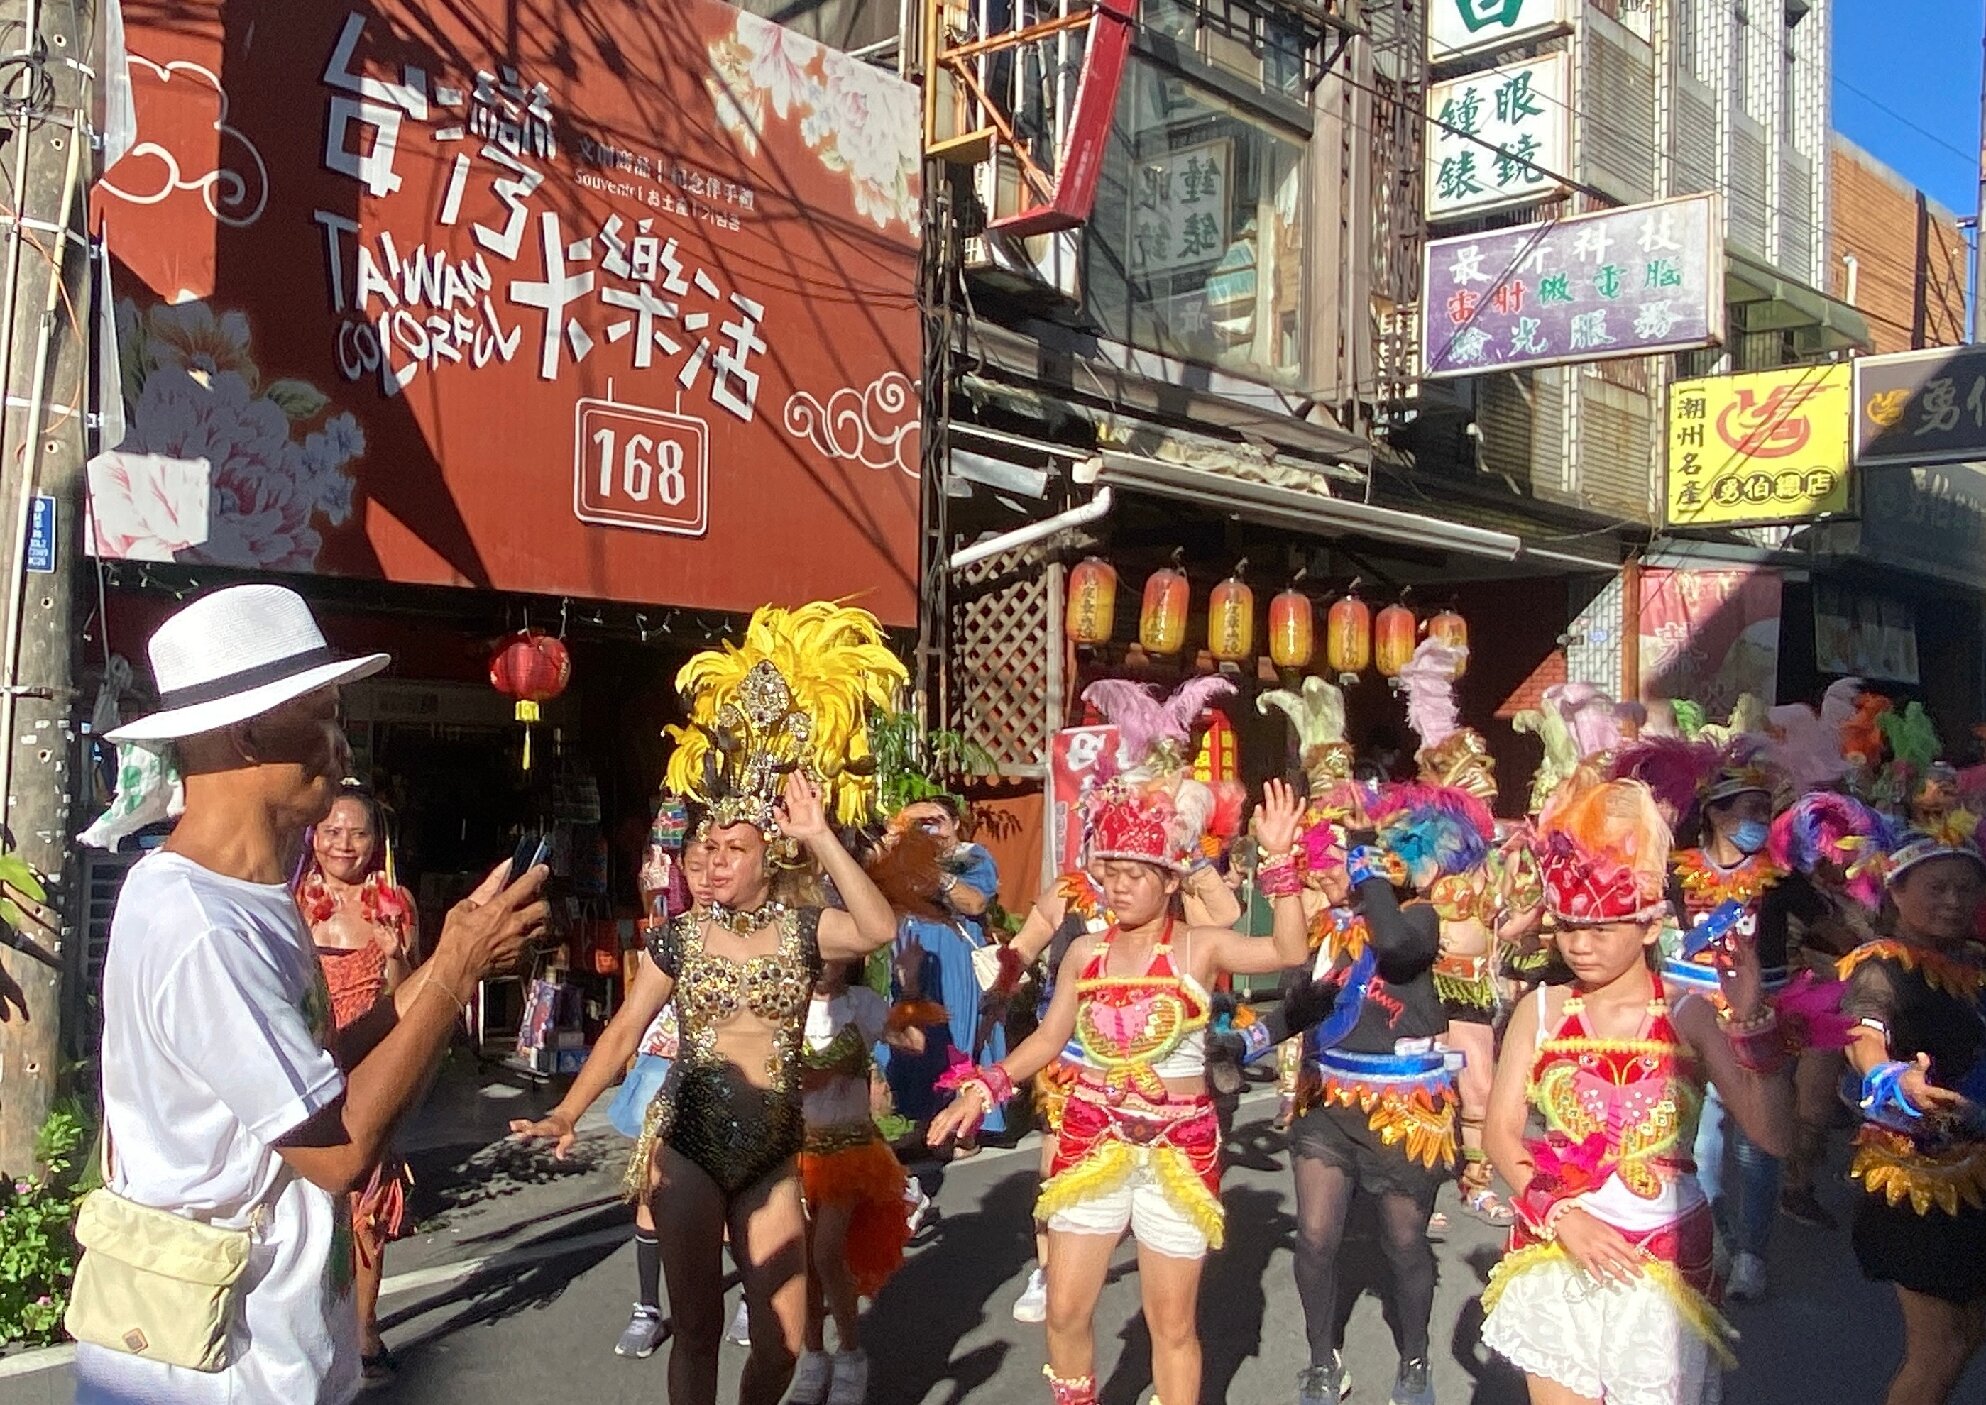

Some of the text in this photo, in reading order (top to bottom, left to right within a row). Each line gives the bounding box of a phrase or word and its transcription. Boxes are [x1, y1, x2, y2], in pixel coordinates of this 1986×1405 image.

[1493, 70, 1546, 187] 眼鏡
[314, 208, 492, 314] TAIWAN
[339, 295, 522, 397] COLORFUL
[593, 428, 685, 506] 168
